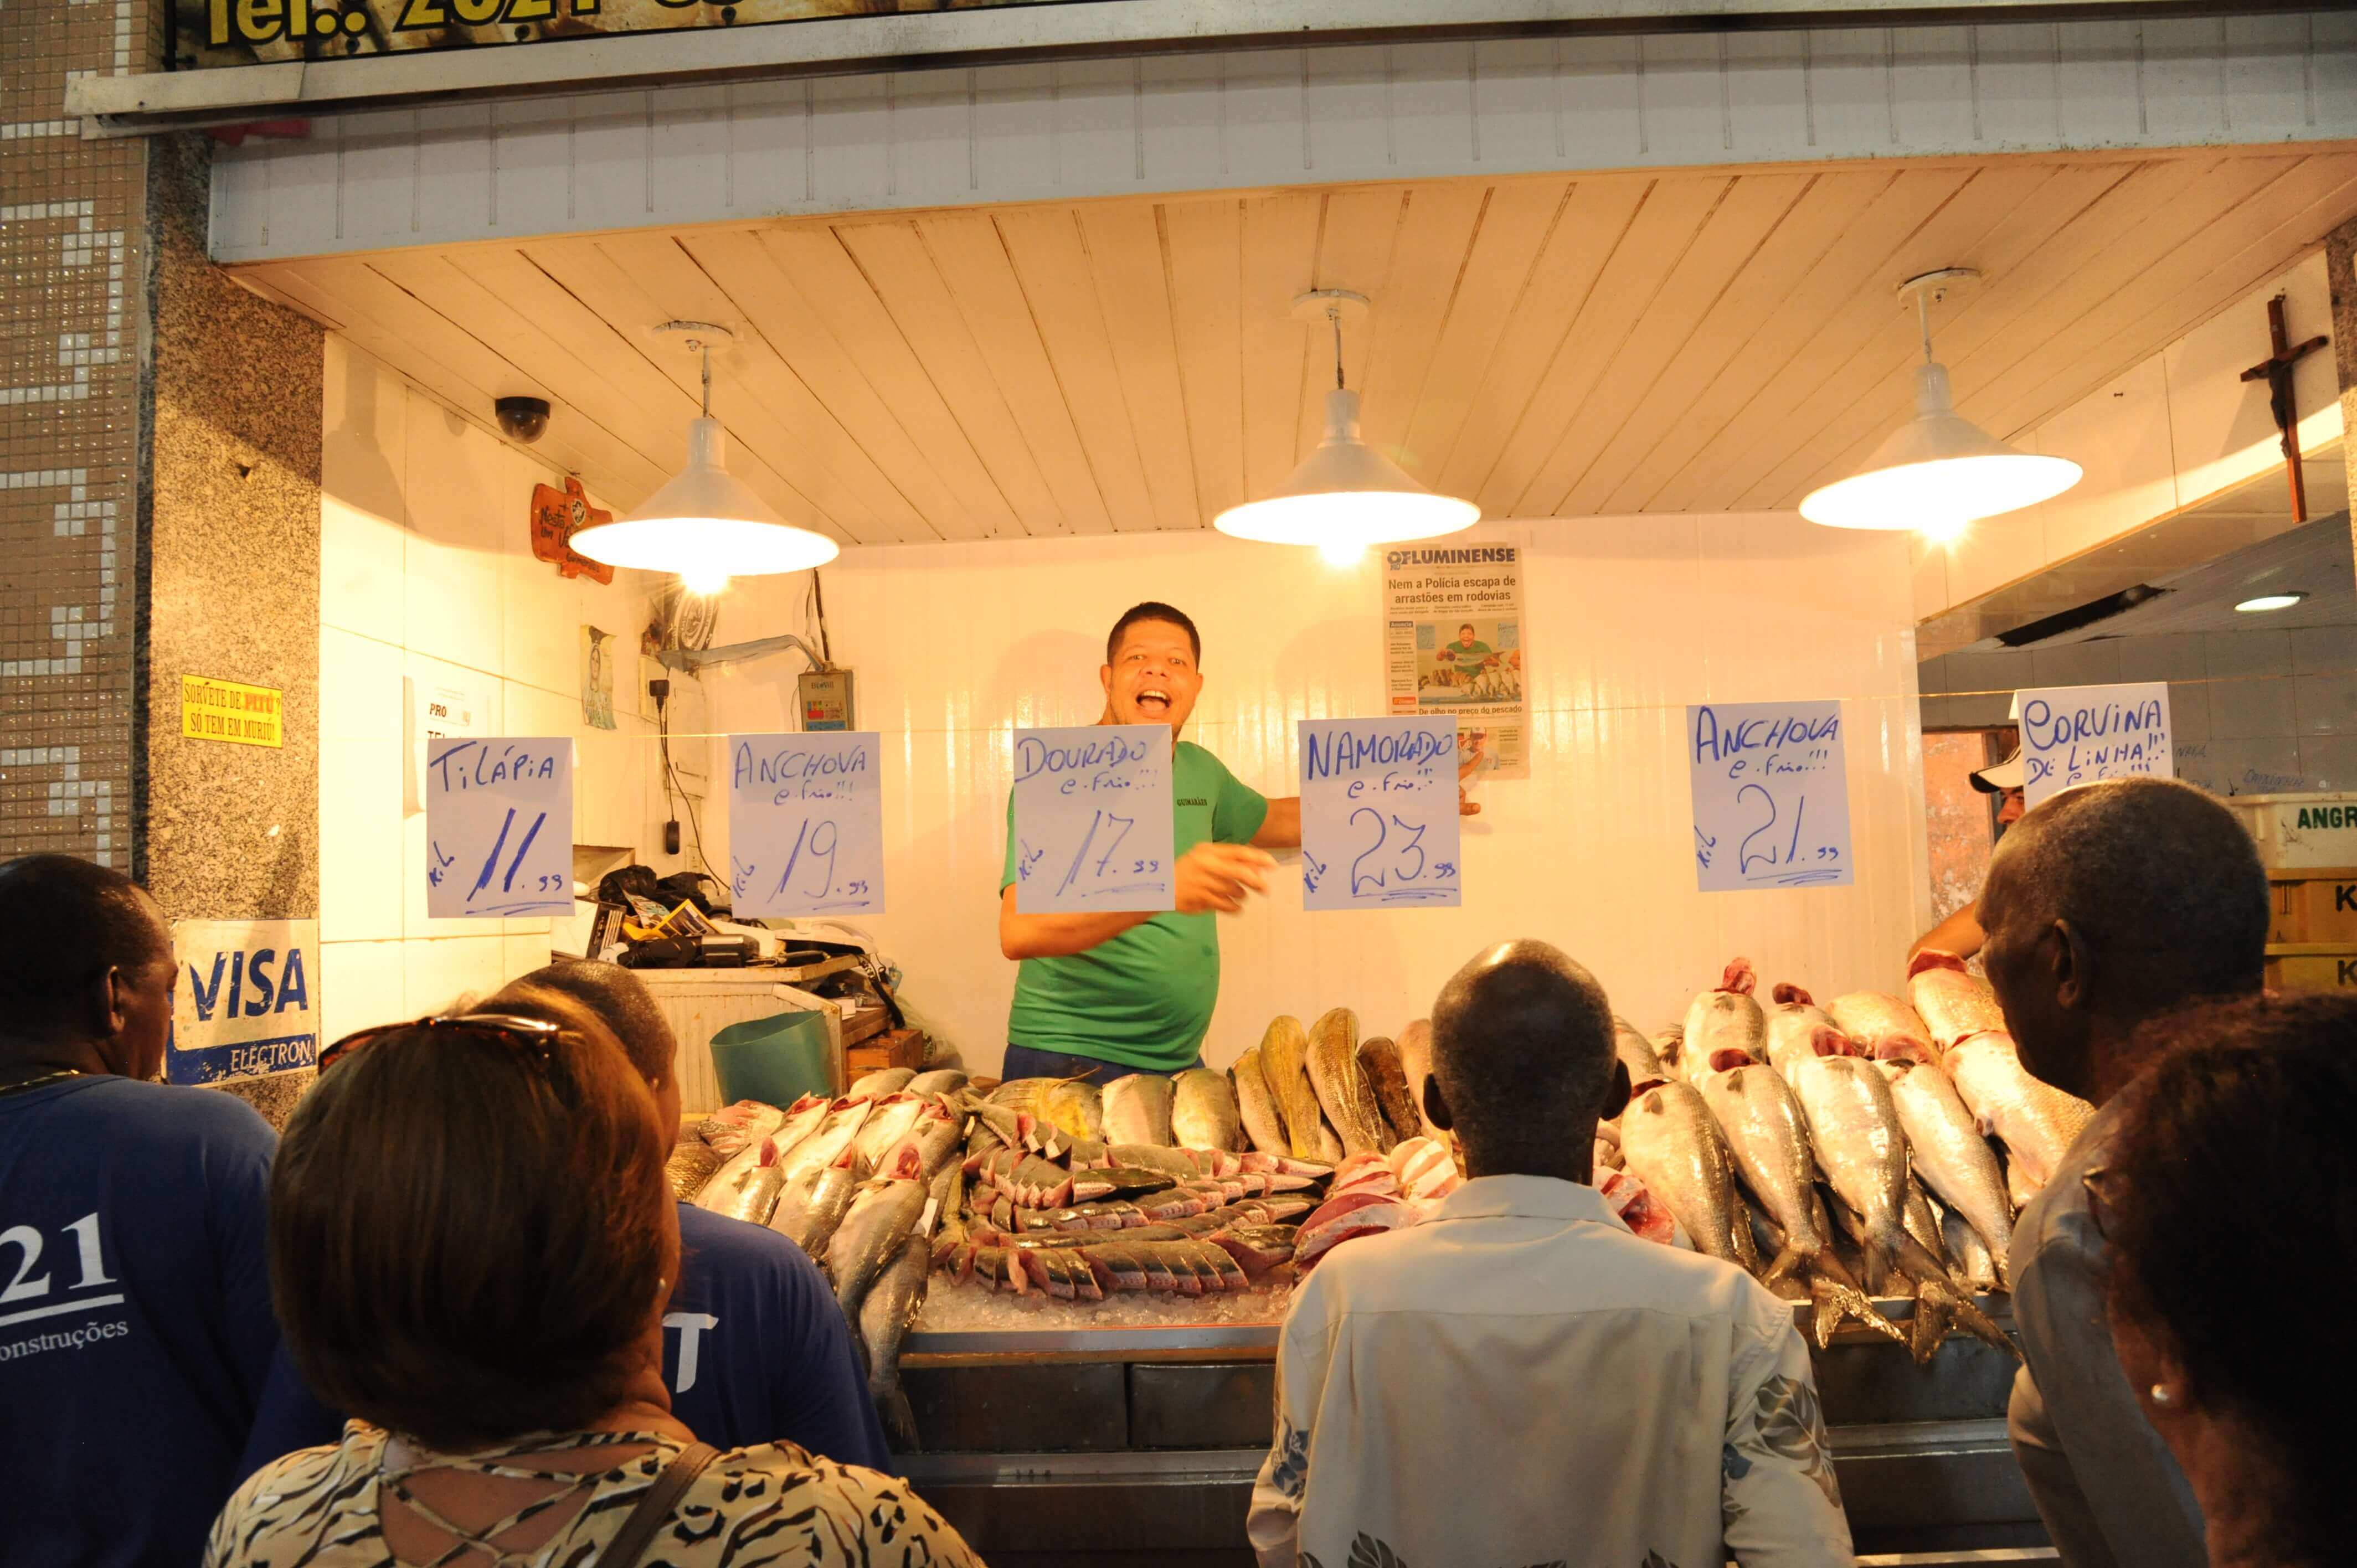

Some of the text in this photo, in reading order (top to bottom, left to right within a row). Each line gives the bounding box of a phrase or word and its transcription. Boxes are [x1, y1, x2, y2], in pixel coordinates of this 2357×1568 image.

[1388, 575, 1516, 589] Nem a Polícia escapa de
[1395, 592, 1444, 604] arrastões
[1466, 590, 1511, 601] rodovias
[184, 683, 227, 708] SORVETE
[230, 690, 241, 709] DE
[1459, 708, 1479, 716] preço
[1481, 706, 1490, 714] do
[1492, 705, 1522, 715] pescado
[191, 707, 202, 733] SÓ
[205, 715, 225, 735] TEM
[228, 718, 241, 737] EM
[1696, 705, 1839, 764] ANCHOVA
[735, 741, 866, 789] ANCHOVA
[1015, 736, 1146, 782] DOURADO
[1308, 731, 1453, 780] NAMORADO
[189, 948, 309, 1022] VISA
[230, 1039, 311, 1072] ELECTRON
